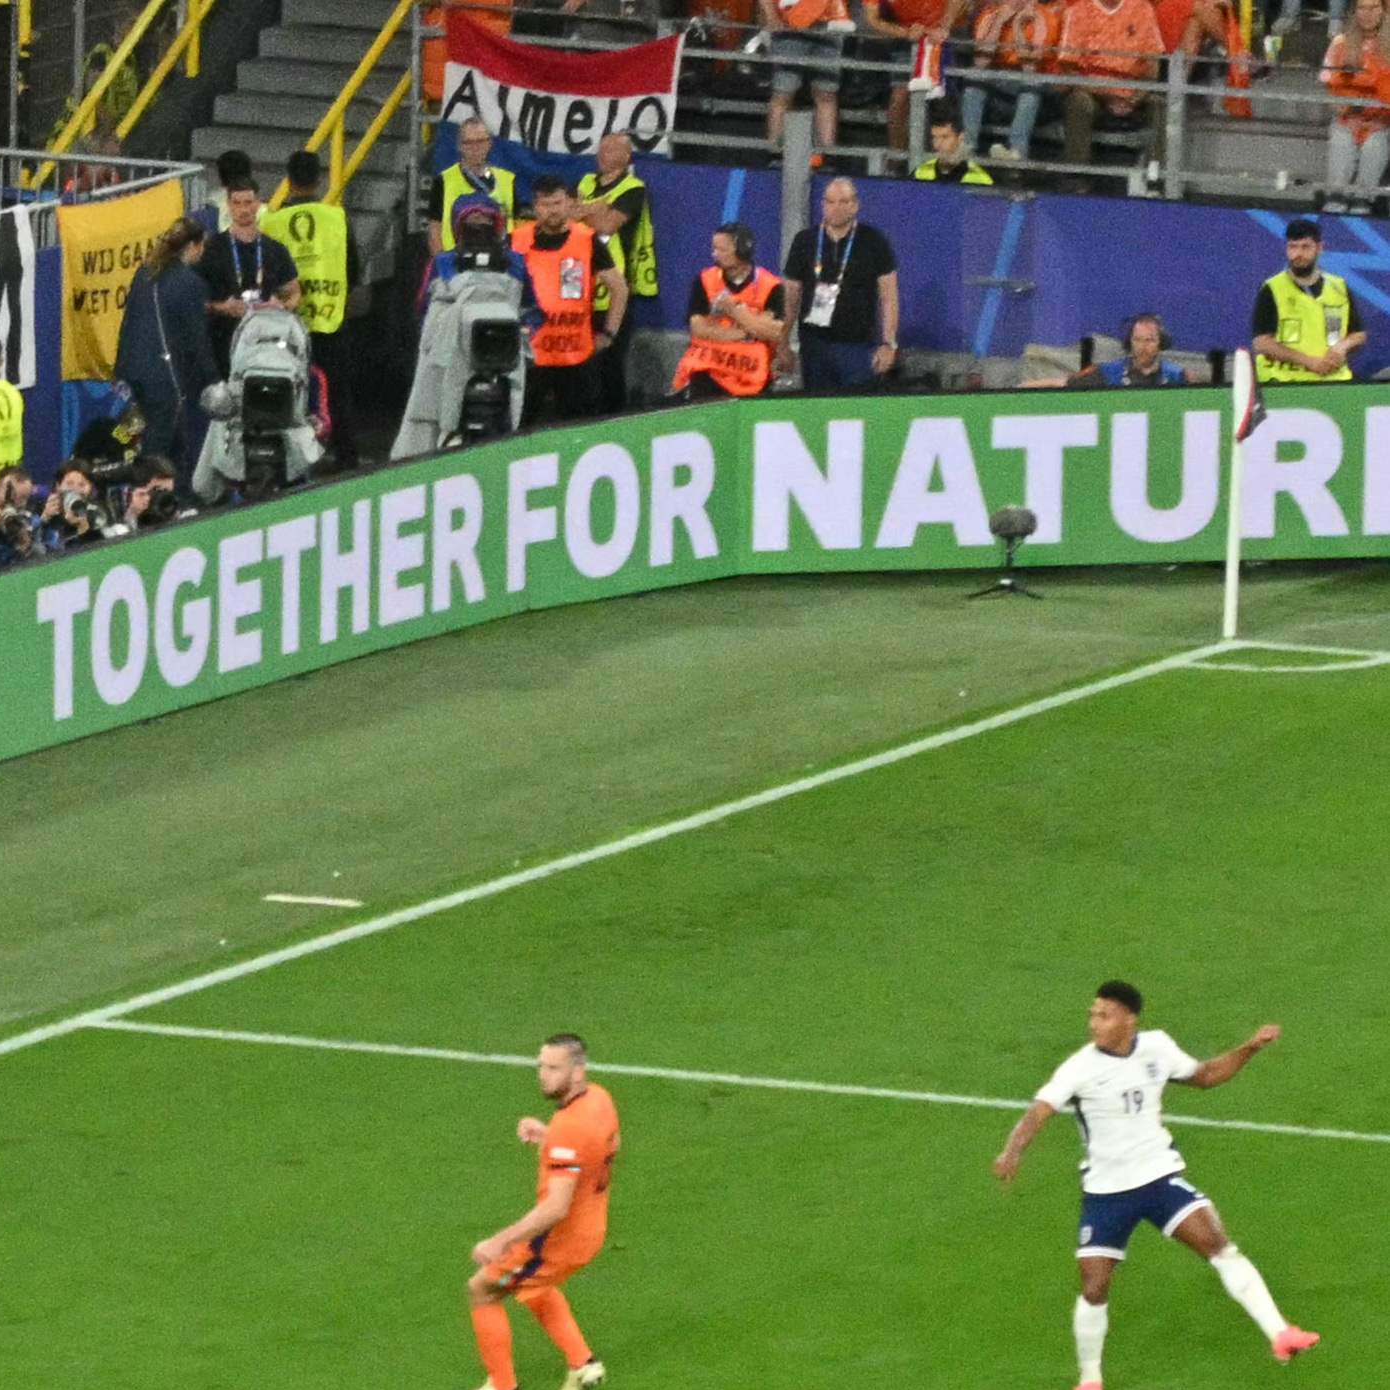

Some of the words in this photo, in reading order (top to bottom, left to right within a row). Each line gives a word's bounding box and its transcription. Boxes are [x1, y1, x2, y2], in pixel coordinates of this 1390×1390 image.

[442, 70, 668, 152] Almelo
[37, 473, 485, 720] TOGETHER
[506, 431, 718, 594] FOR
[1121, 1089, 1144, 1114] 19
